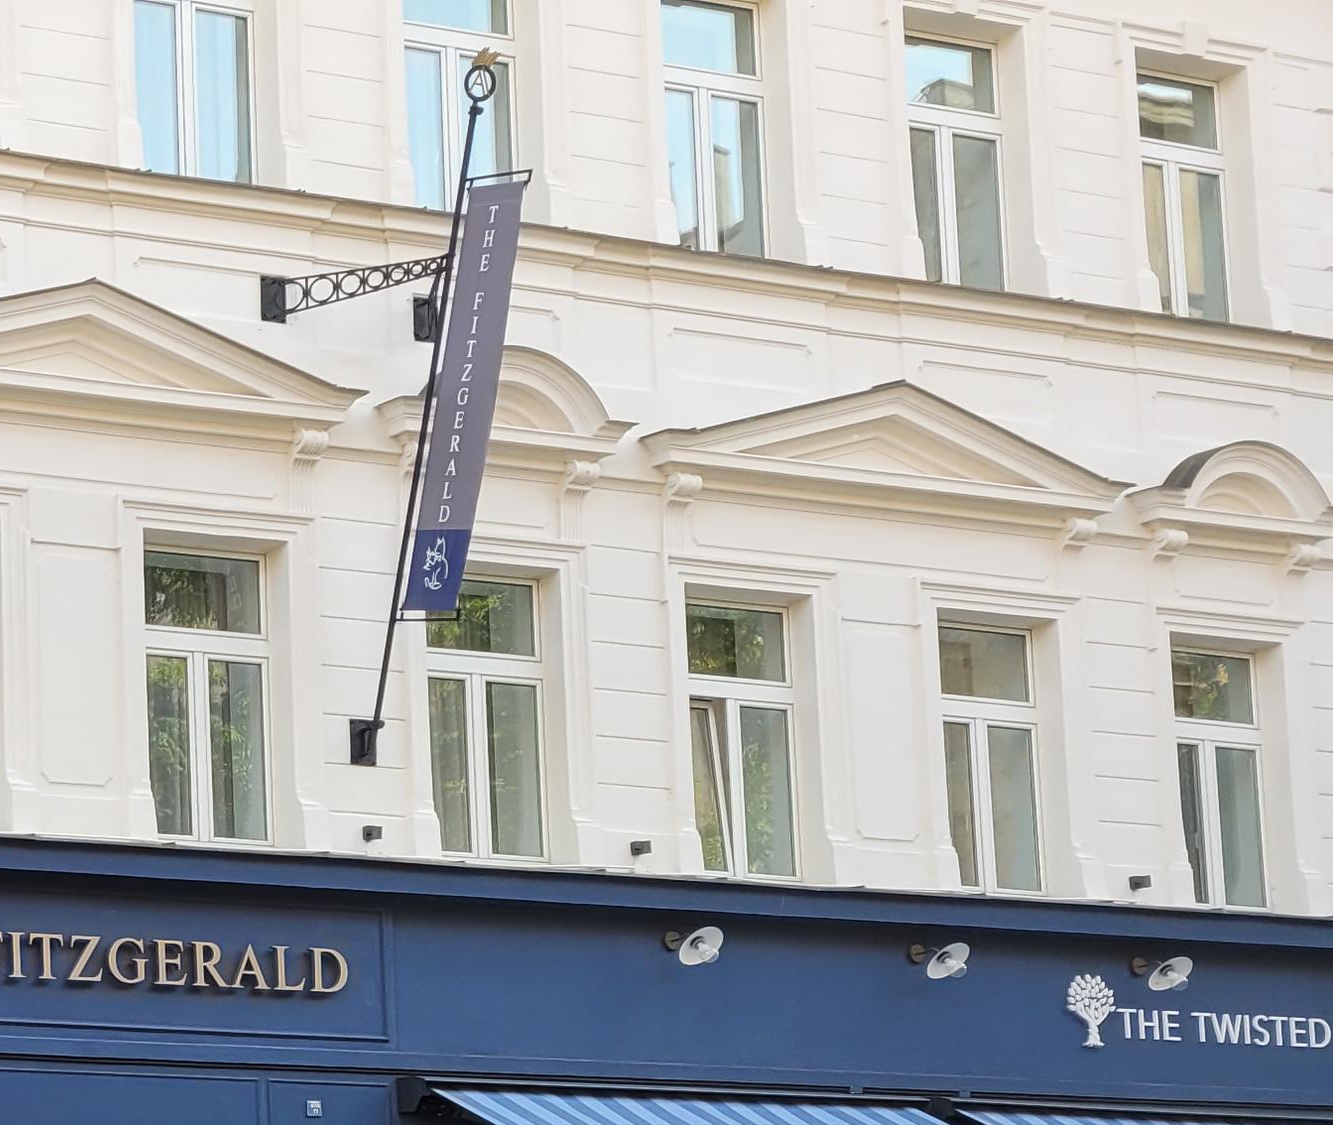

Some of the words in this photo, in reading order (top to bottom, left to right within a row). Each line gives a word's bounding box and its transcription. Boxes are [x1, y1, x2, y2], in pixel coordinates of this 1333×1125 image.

[478, 205, 499, 273] THE
[437, 292, 485, 524] FITZGERALD
[1115, 1007, 1182, 1042] THE
[1190, 1012, 1332, 1049] TWISTED
